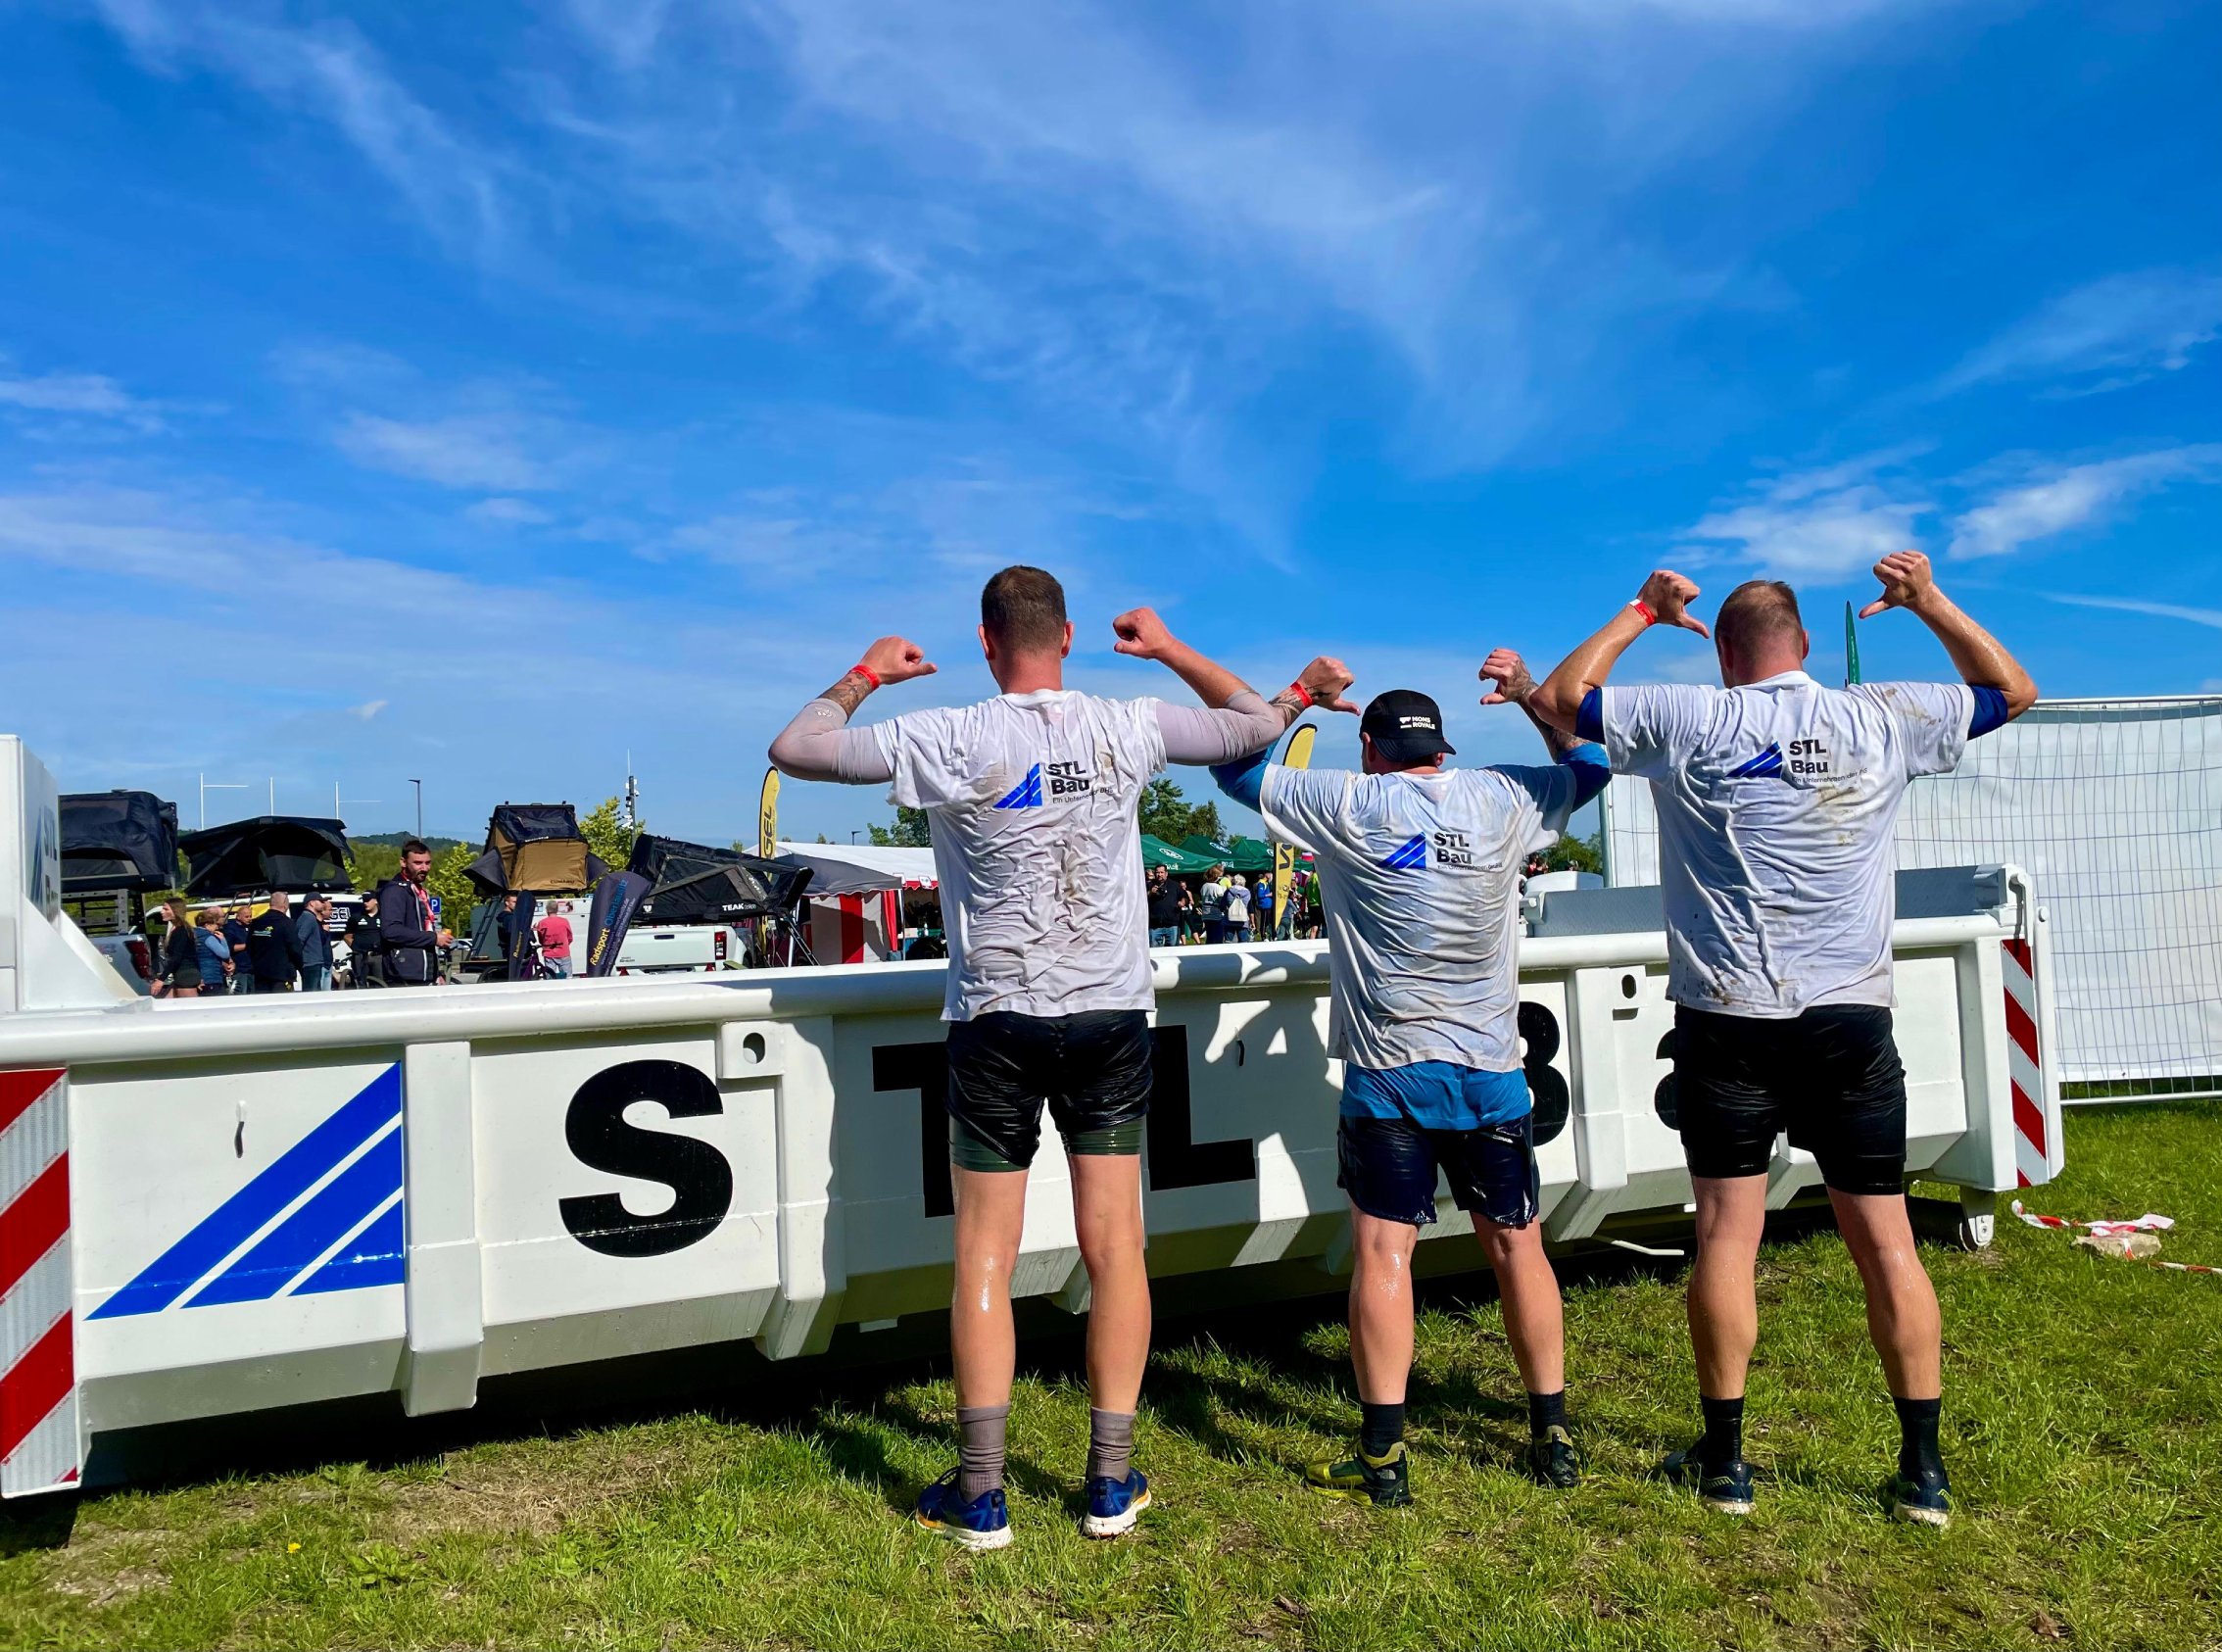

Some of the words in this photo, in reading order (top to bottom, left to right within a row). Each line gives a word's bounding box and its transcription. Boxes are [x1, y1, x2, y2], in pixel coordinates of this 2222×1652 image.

[1789, 739, 1827, 755] STL
[1047, 760, 1087, 775] STL
[1790, 759, 1829, 774] Bau
[1050, 779, 1090, 795] Bau
[1433, 832, 1470, 848] STL
[1436, 848, 1473, 864] Bau
[431, 899, 439, 911] P
[590, 927, 610, 965] Radsport
